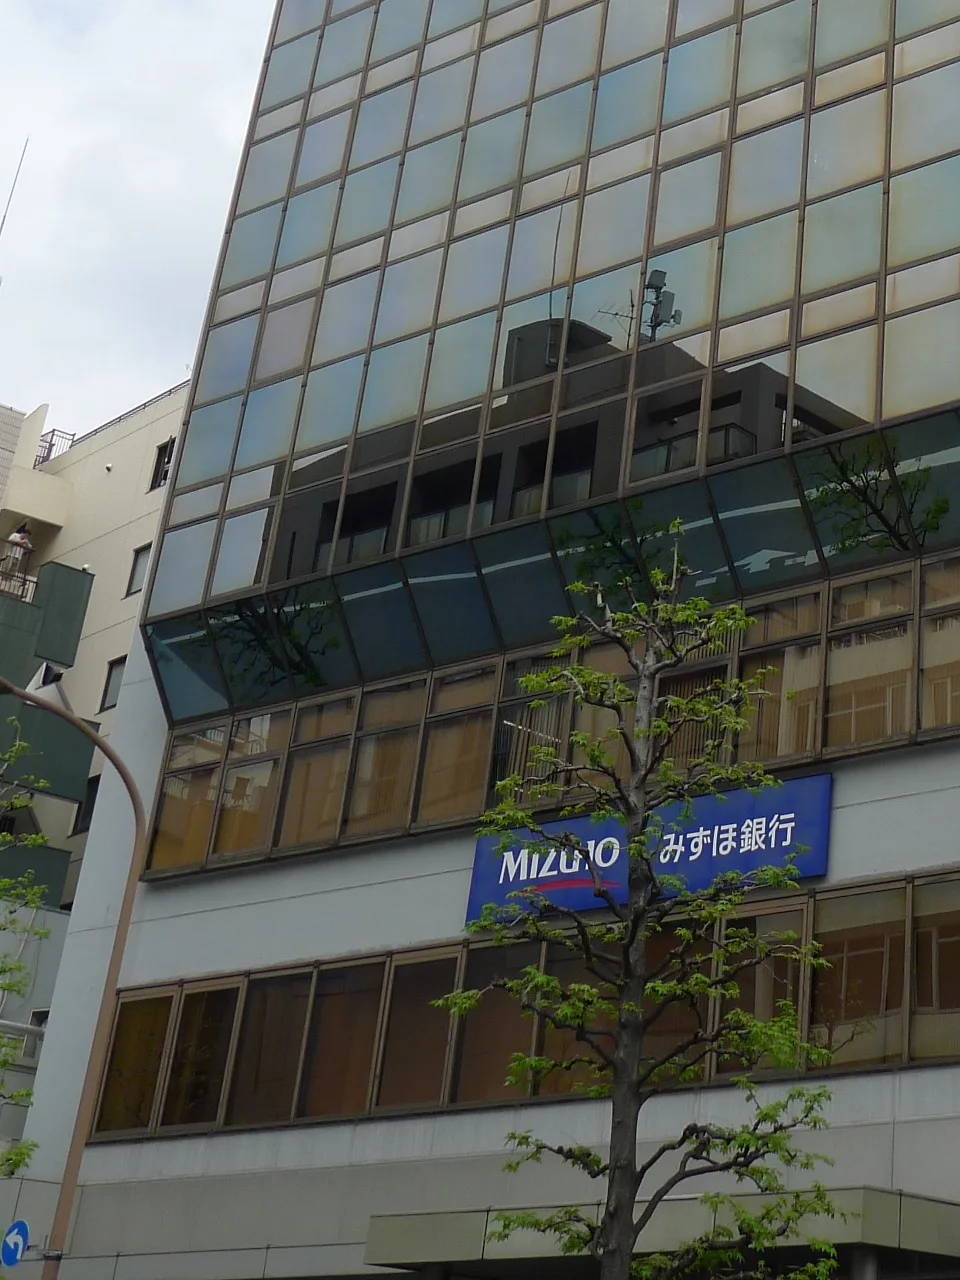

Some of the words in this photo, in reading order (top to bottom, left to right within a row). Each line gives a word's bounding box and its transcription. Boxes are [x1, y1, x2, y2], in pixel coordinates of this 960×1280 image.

[659, 812, 796, 864] みずほ銀行
